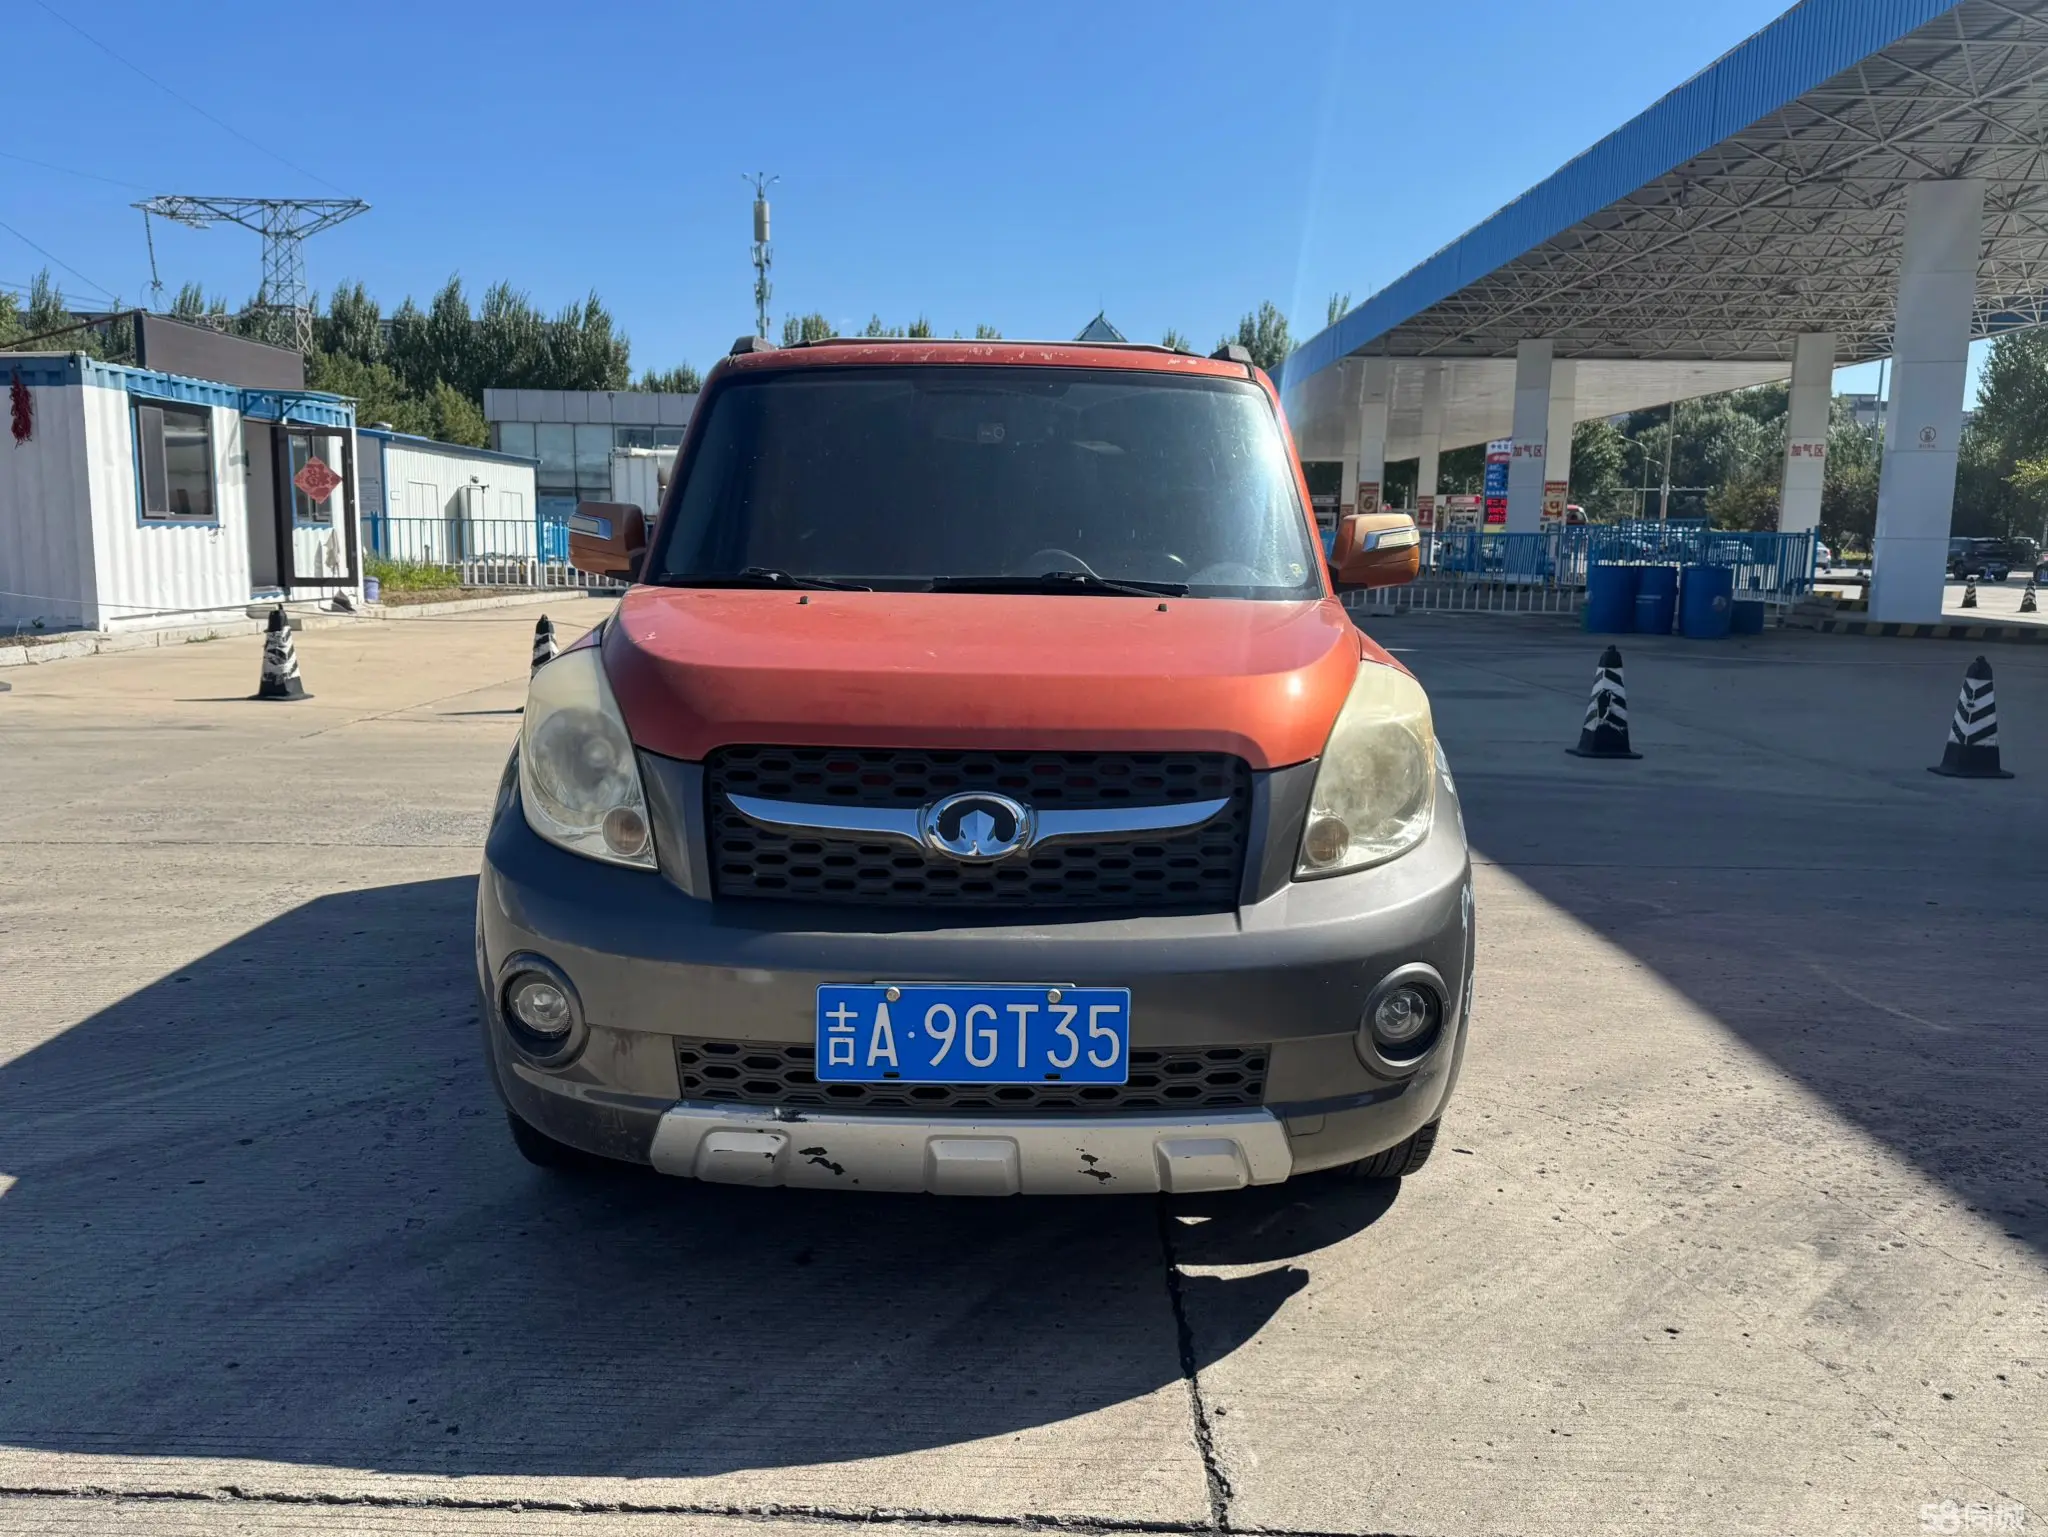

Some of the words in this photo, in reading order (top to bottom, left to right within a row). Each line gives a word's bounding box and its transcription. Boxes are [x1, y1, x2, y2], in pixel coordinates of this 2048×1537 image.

[1513, 444, 1543, 458] 加气区
[1790, 444, 1824, 458] 加气区
[825, 1001, 1120, 1068] 吉A·9GT35
